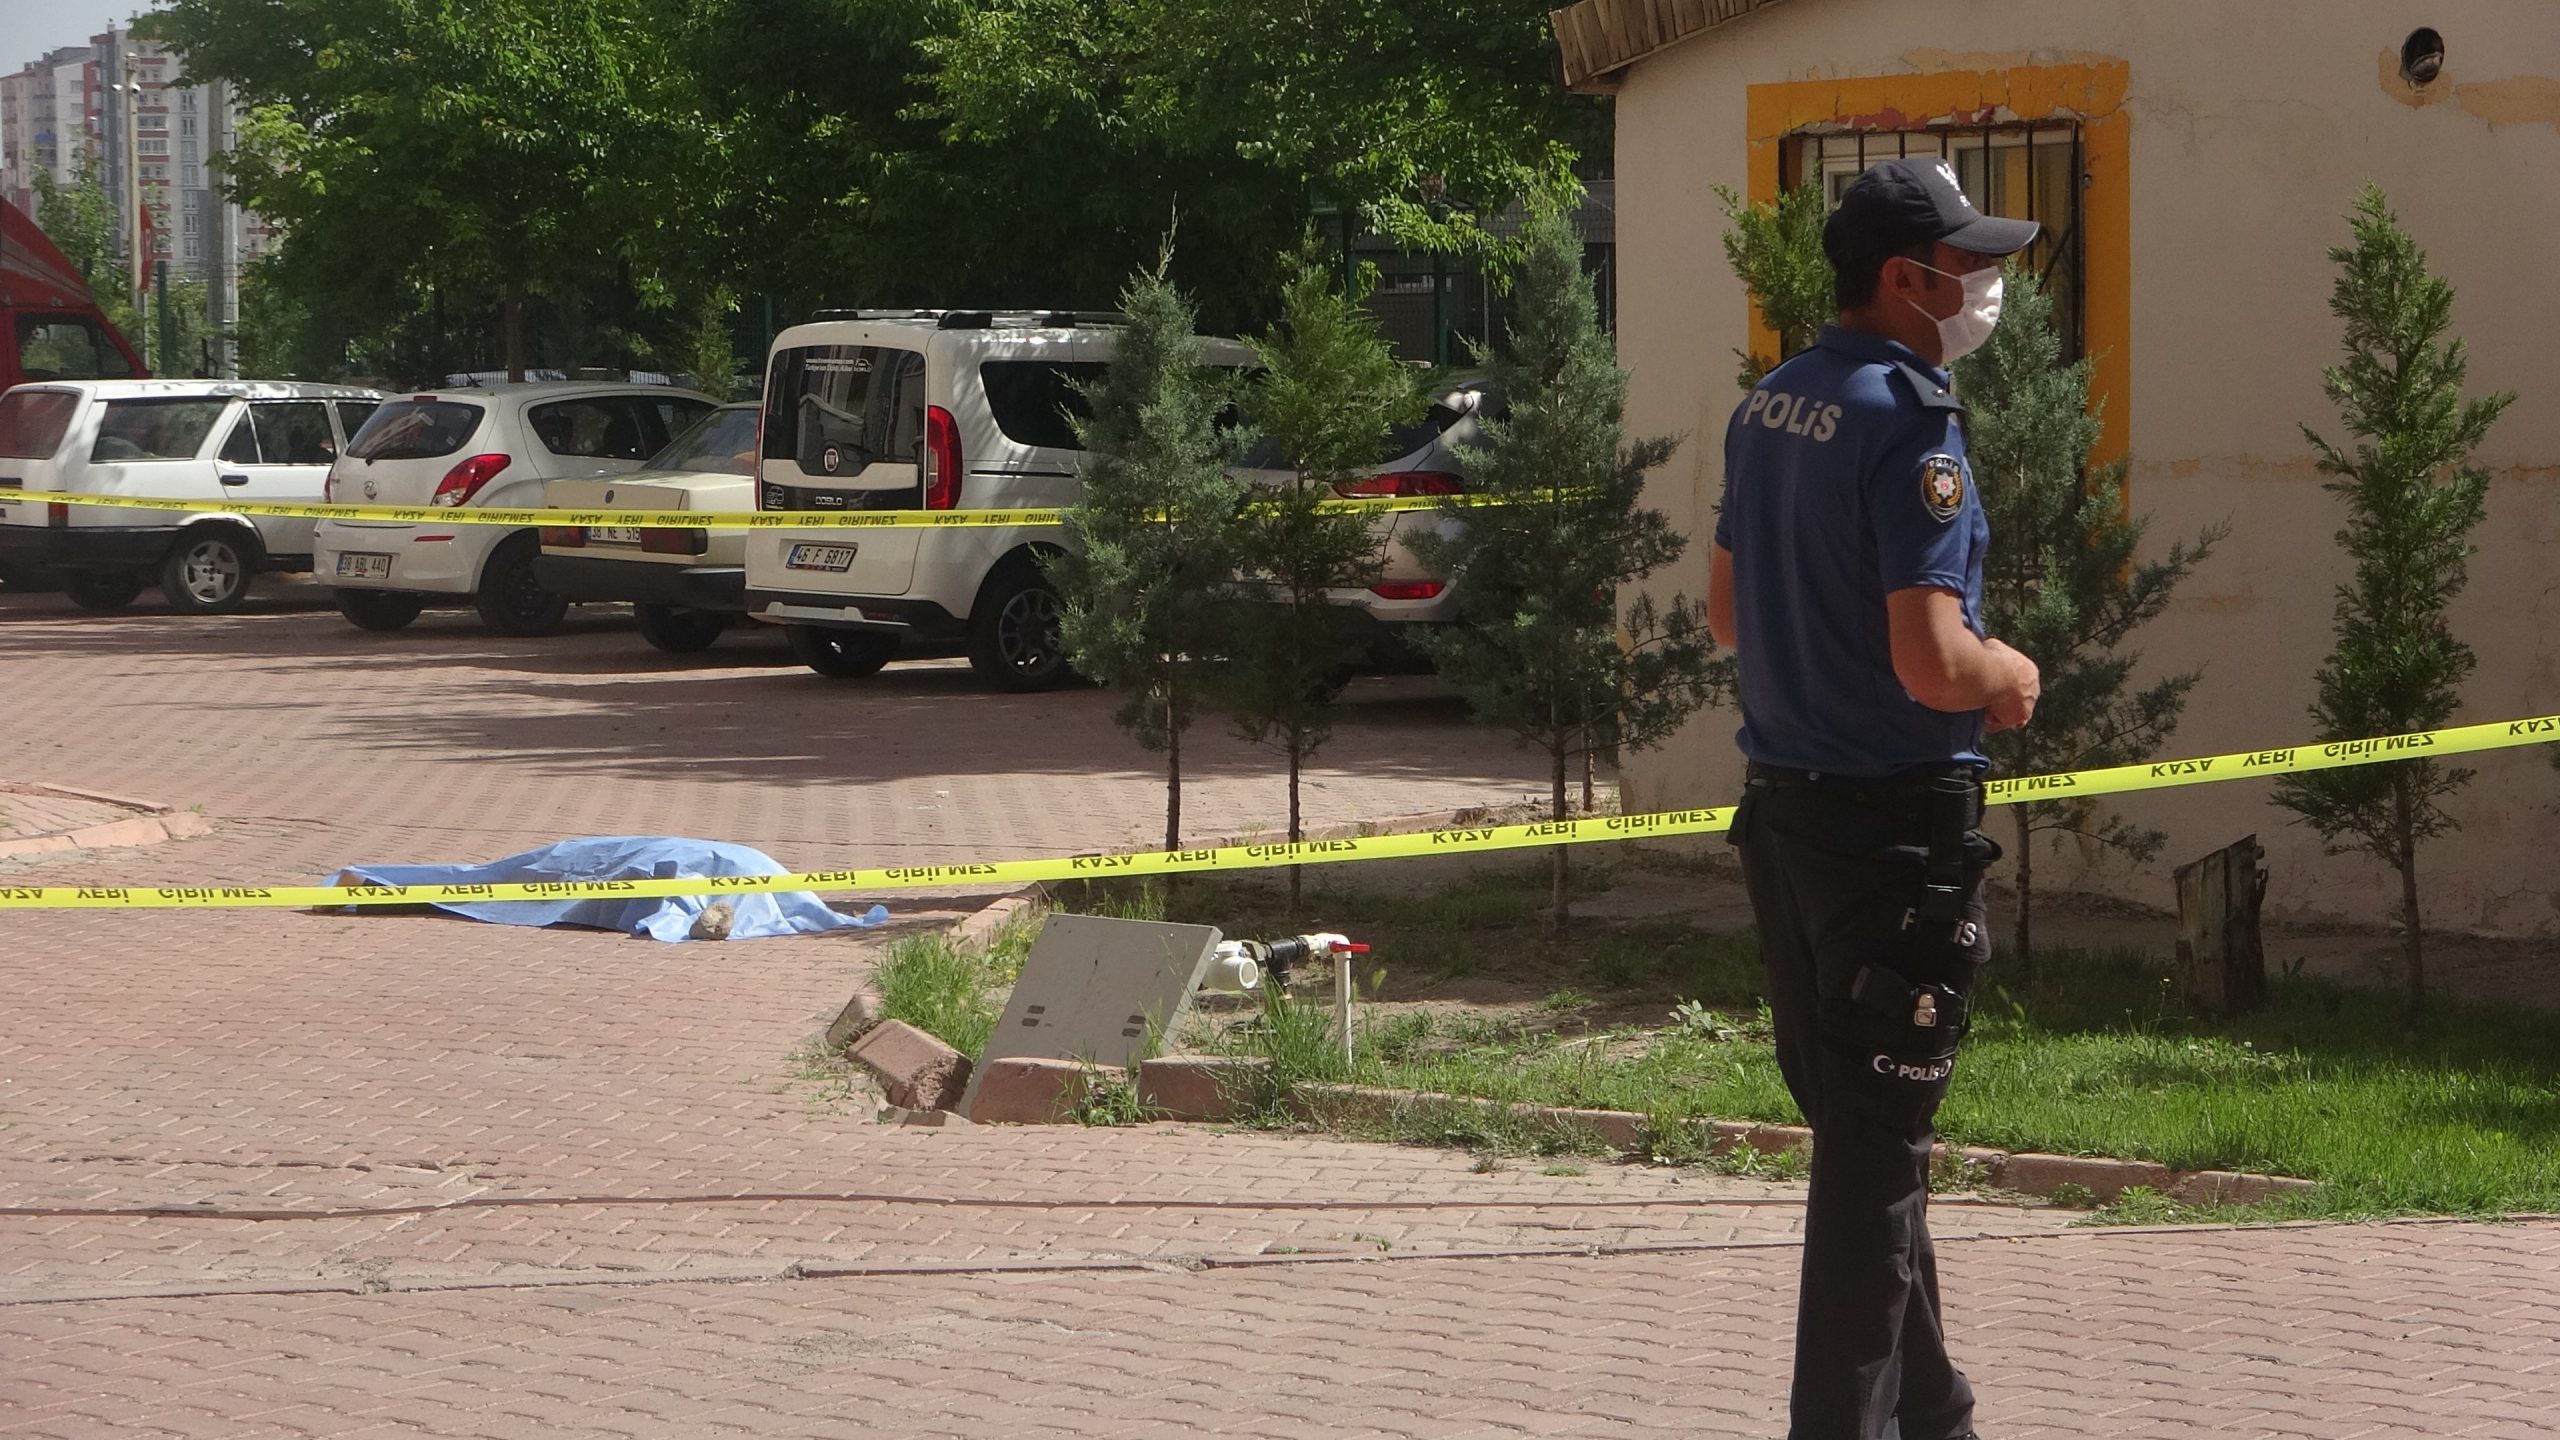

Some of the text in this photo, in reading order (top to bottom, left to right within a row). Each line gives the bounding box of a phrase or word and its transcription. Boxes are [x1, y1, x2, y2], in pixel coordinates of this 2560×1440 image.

[1743, 390, 1843, 442] POLİS
[815, 496, 842, 506] DOBLO
[812, 549, 822, 563] F
[824, 550, 851, 565] 6817
